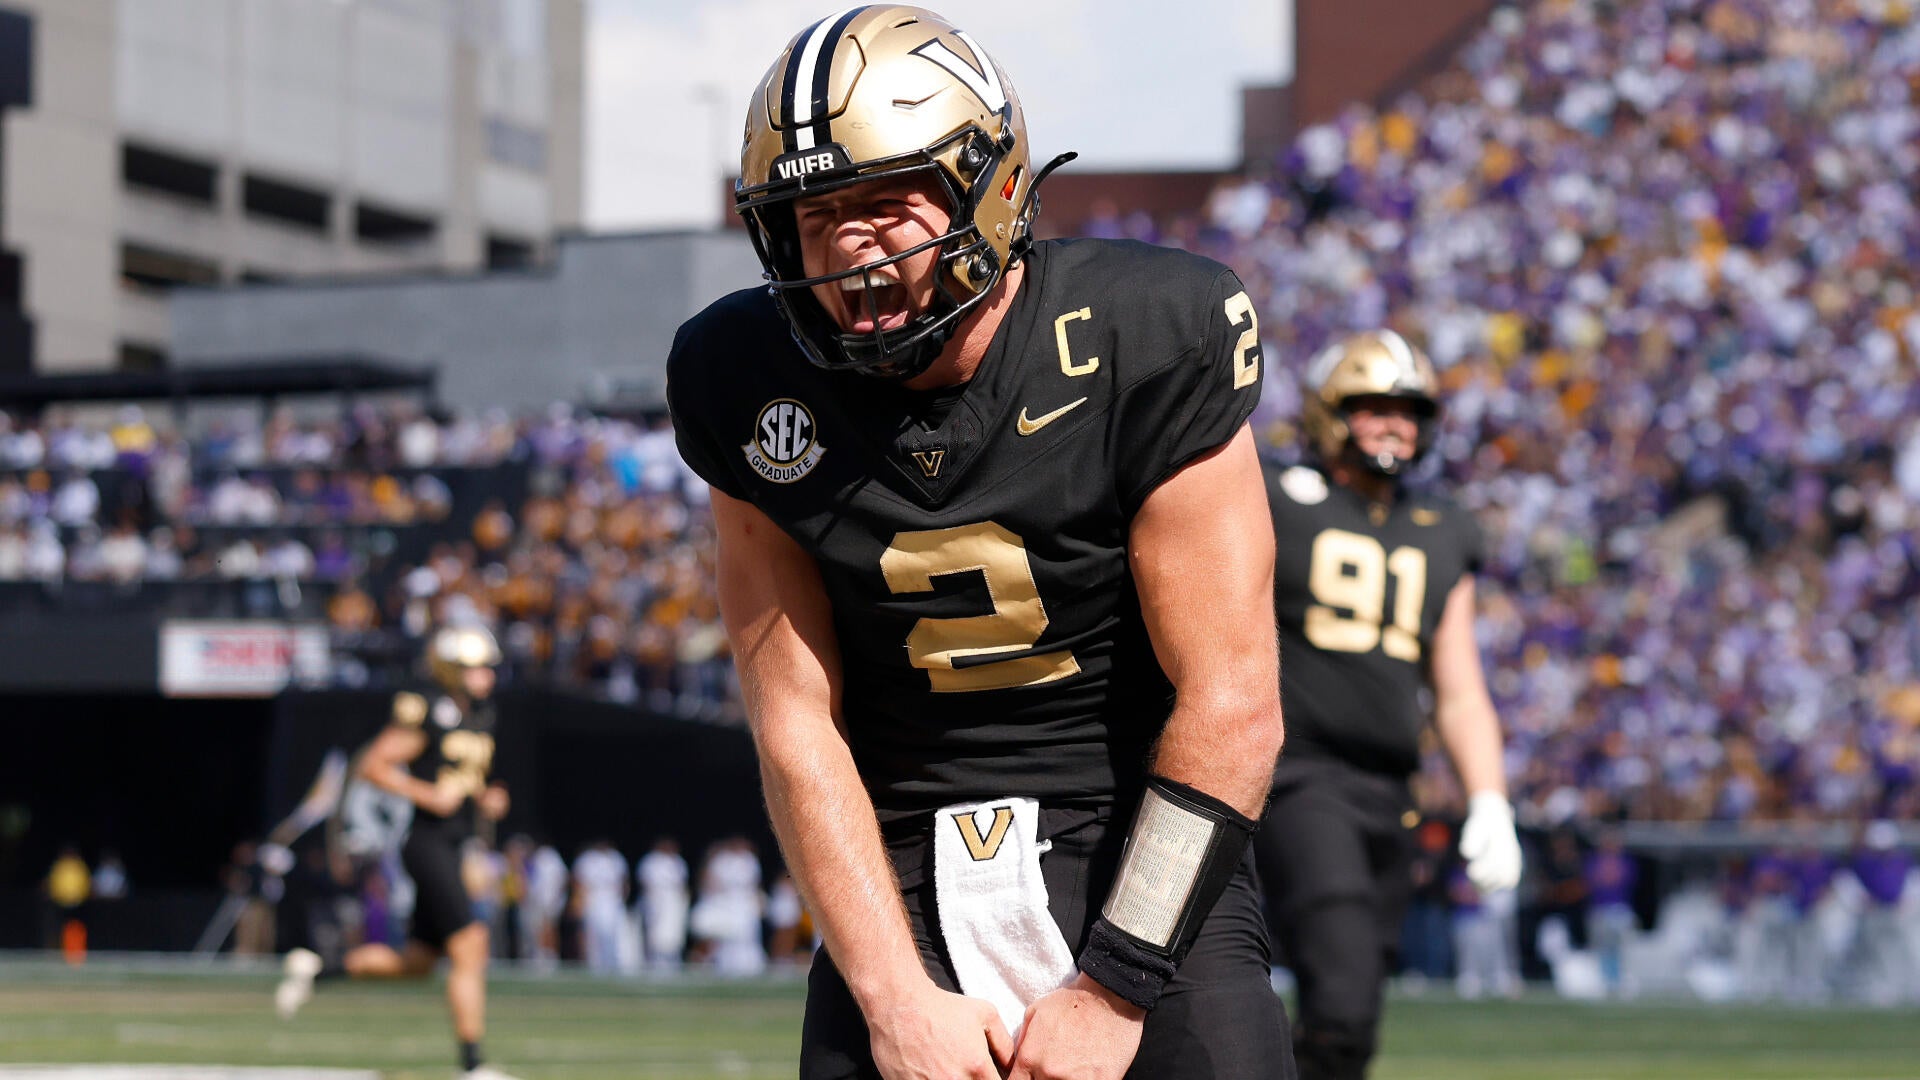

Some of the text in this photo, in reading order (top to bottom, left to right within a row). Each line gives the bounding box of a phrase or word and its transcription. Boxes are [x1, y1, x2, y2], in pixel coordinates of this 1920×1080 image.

[908, 29, 1008, 117] V
[777, 152, 835, 180] VUFB
[1054, 306, 1100, 378] C
[1224, 290, 1259, 390] 2
[760, 403, 811, 461] SEC
[911, 450, 946, 477] V
[751, 455, 814, 481] GRADUATE
[879, 519, 1082, 693] 2
[1303, 527, 1428, 663] 91
[950, 806, 1015, 861] V
